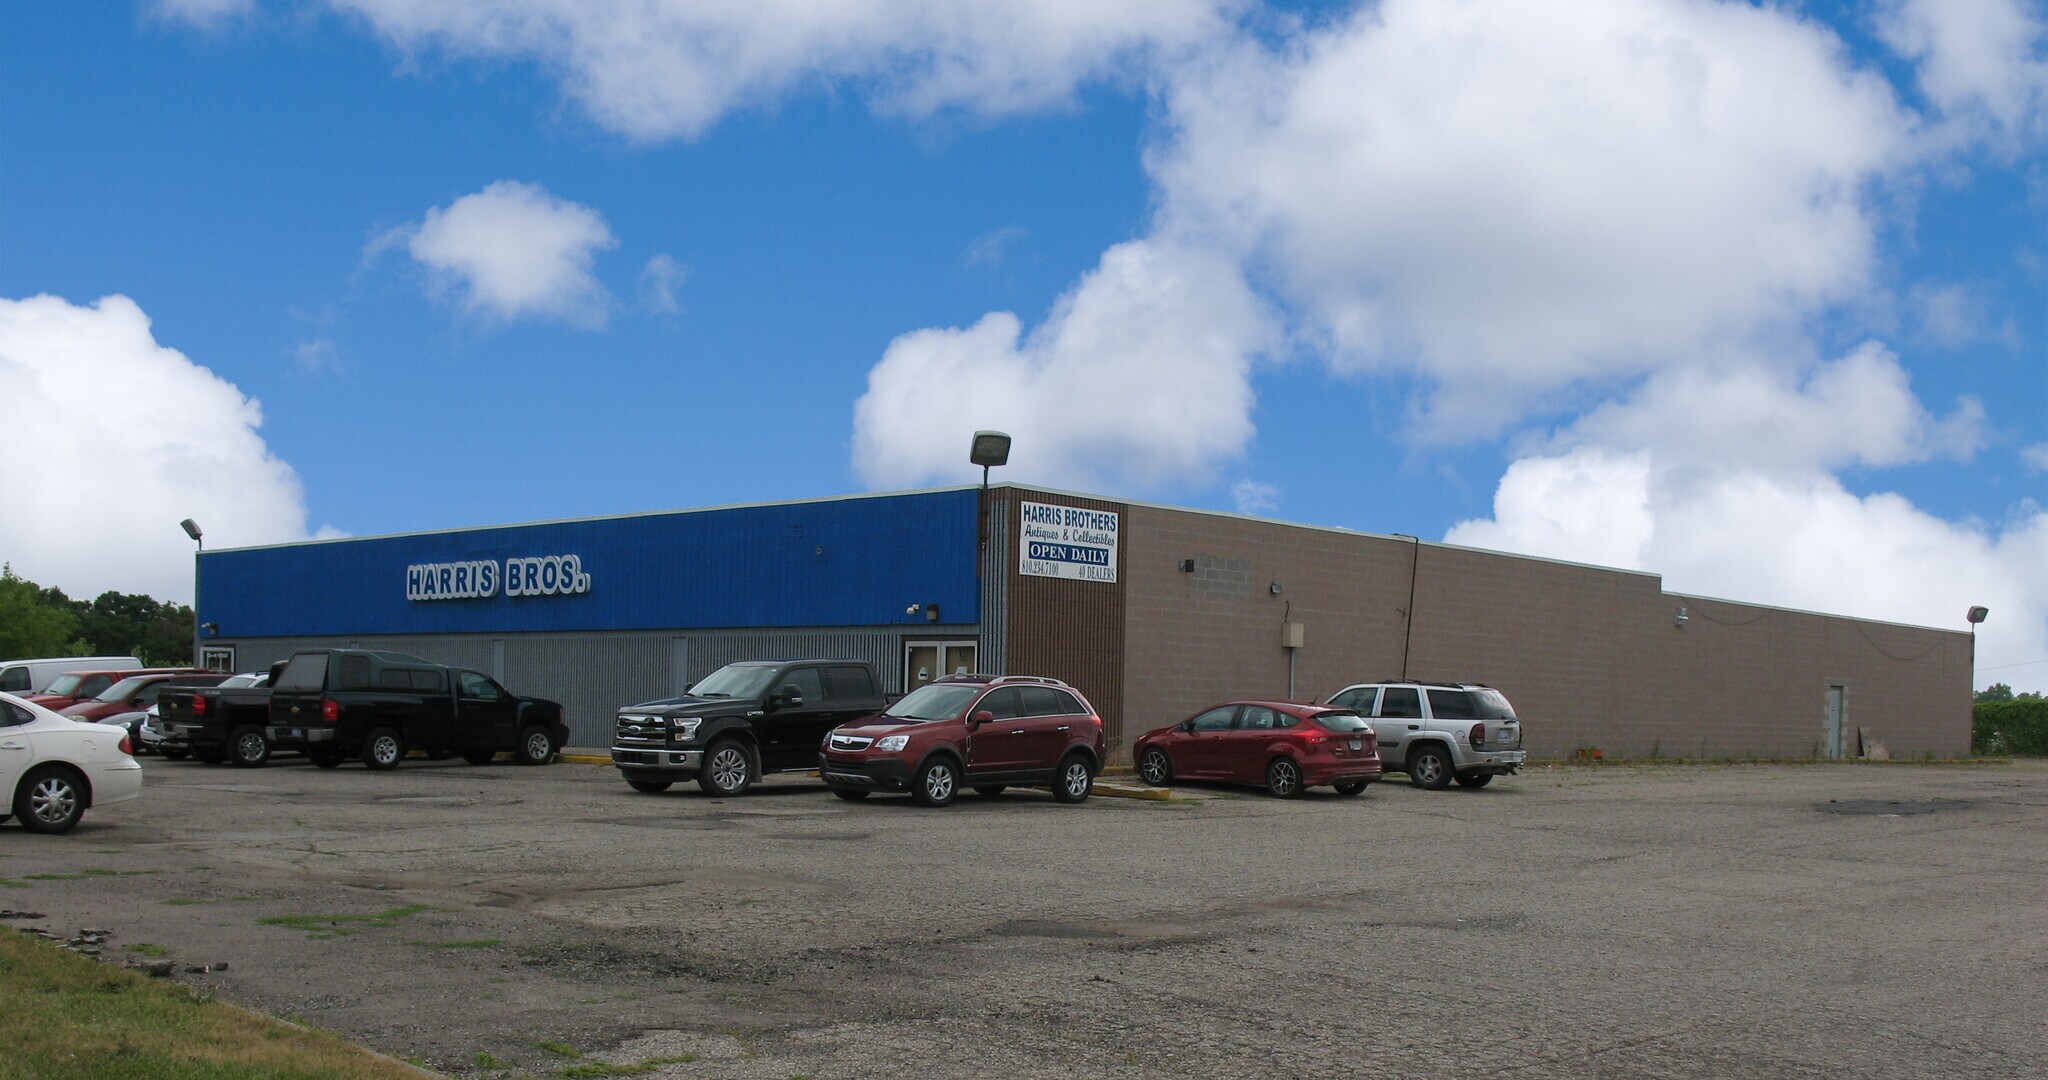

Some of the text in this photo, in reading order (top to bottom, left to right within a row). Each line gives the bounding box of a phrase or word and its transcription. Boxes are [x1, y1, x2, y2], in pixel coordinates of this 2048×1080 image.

[1023, 505, 1116, 532] HARRIS BROTHERS
[1024, 524, 1115, 547] Antiques & Collectibles
[1030, 544, 1107, 564] OPEN DAILY
[408, 556, 588, 599] HARRIS BROS.
[1087, 566, 1115, 581] DEALERS
